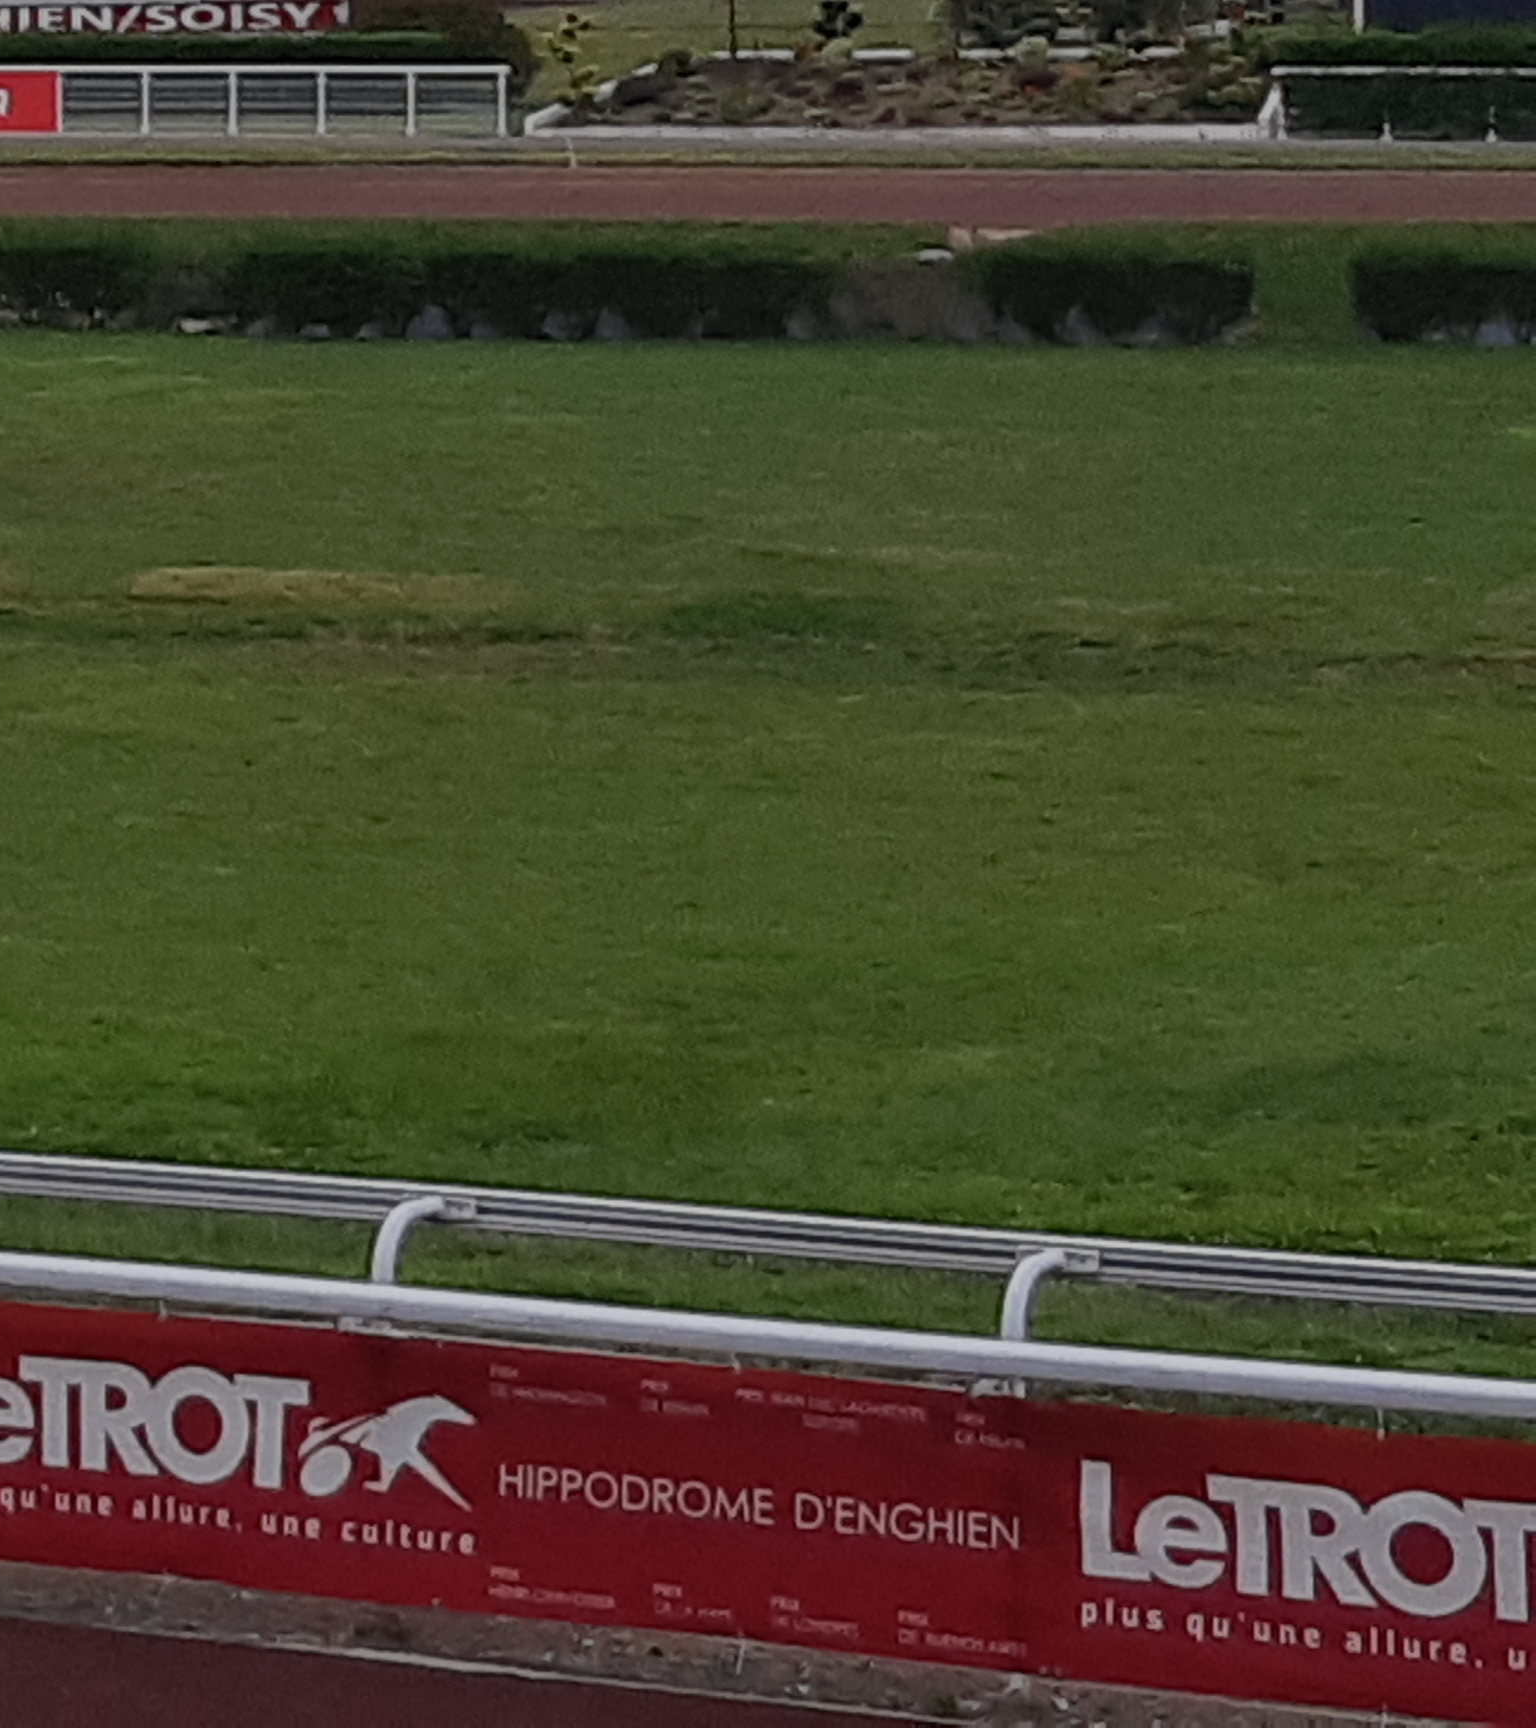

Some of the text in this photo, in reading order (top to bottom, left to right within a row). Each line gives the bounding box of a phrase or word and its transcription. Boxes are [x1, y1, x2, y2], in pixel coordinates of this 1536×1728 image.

[260, 1512, 322, 1540] une
[340, 1516, 478, 1556] culture
[497, 1463, 1021, 1552] HIPPODROME D'ENGHIEN
[1079, 1458, 1536, 1624] LeTROT
[1080, 1597, 1165, 1631] plus
[1185, 1611, 1322, 1650] qu'une
